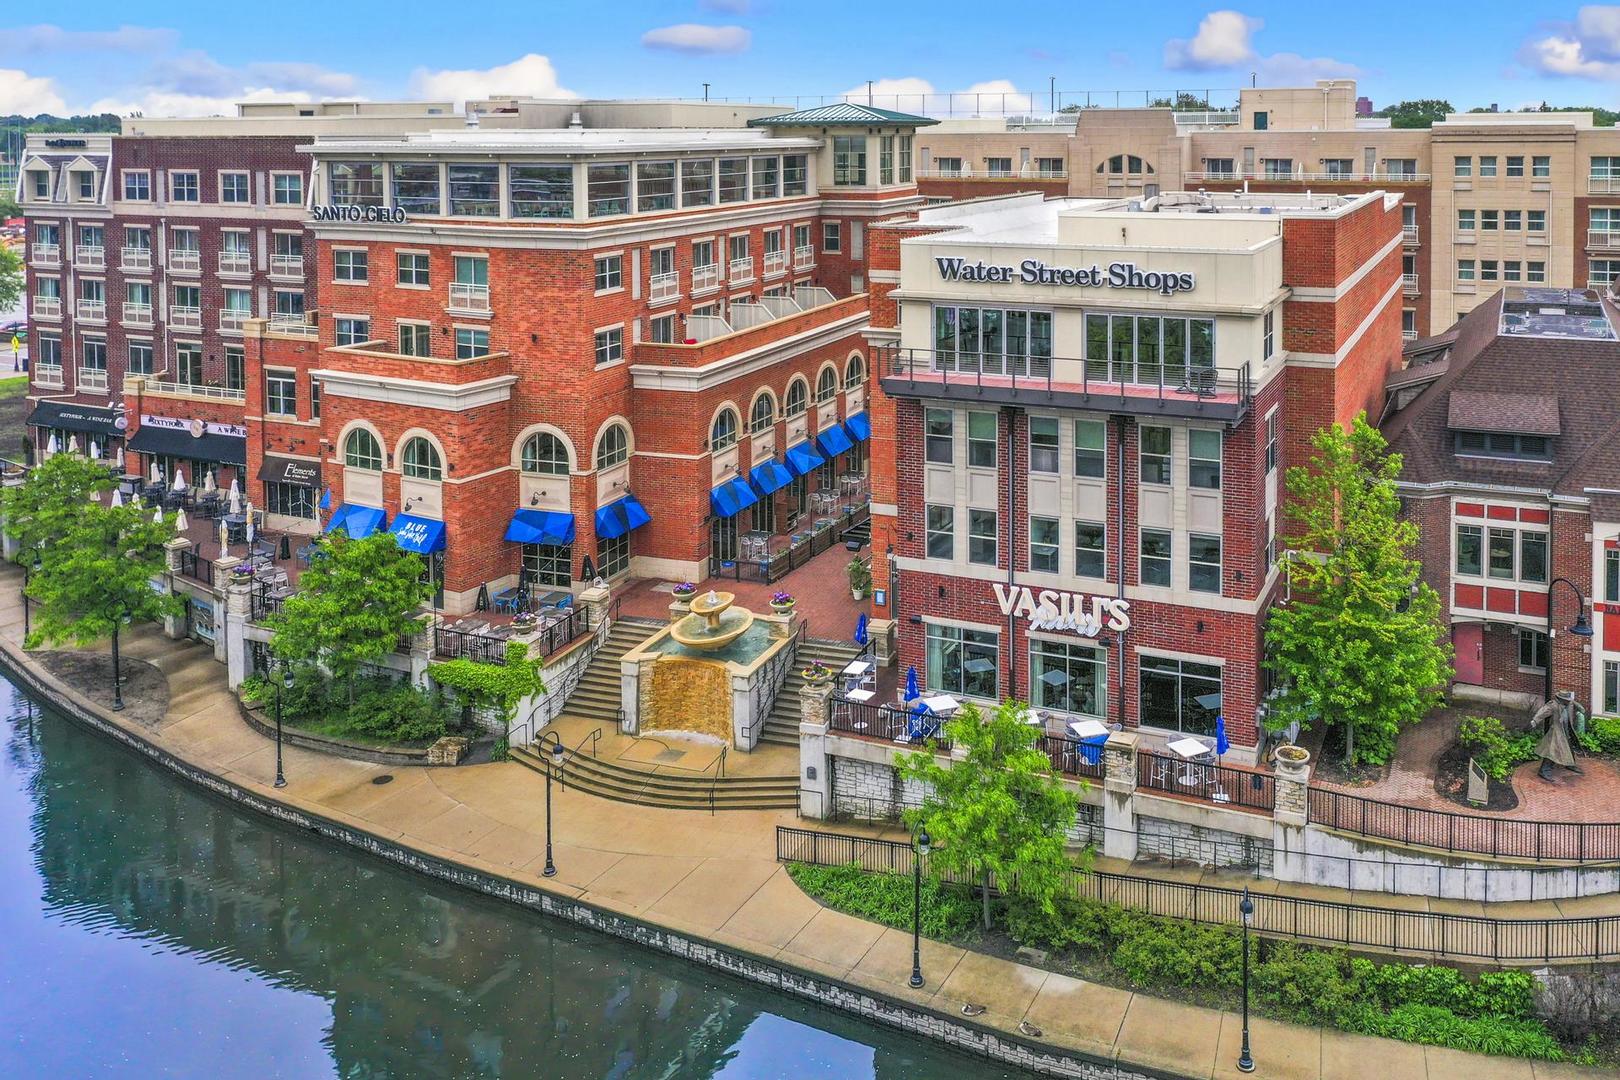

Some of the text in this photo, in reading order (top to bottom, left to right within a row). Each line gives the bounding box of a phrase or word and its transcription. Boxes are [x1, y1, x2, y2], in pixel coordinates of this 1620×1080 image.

[313, 205, 406, 224] SANTO CIELO
[935, 257, 1194, 296] Water Street Shops
[284, 463, 317, 477] Elements
[405, 521, 428, 532] BLUE
